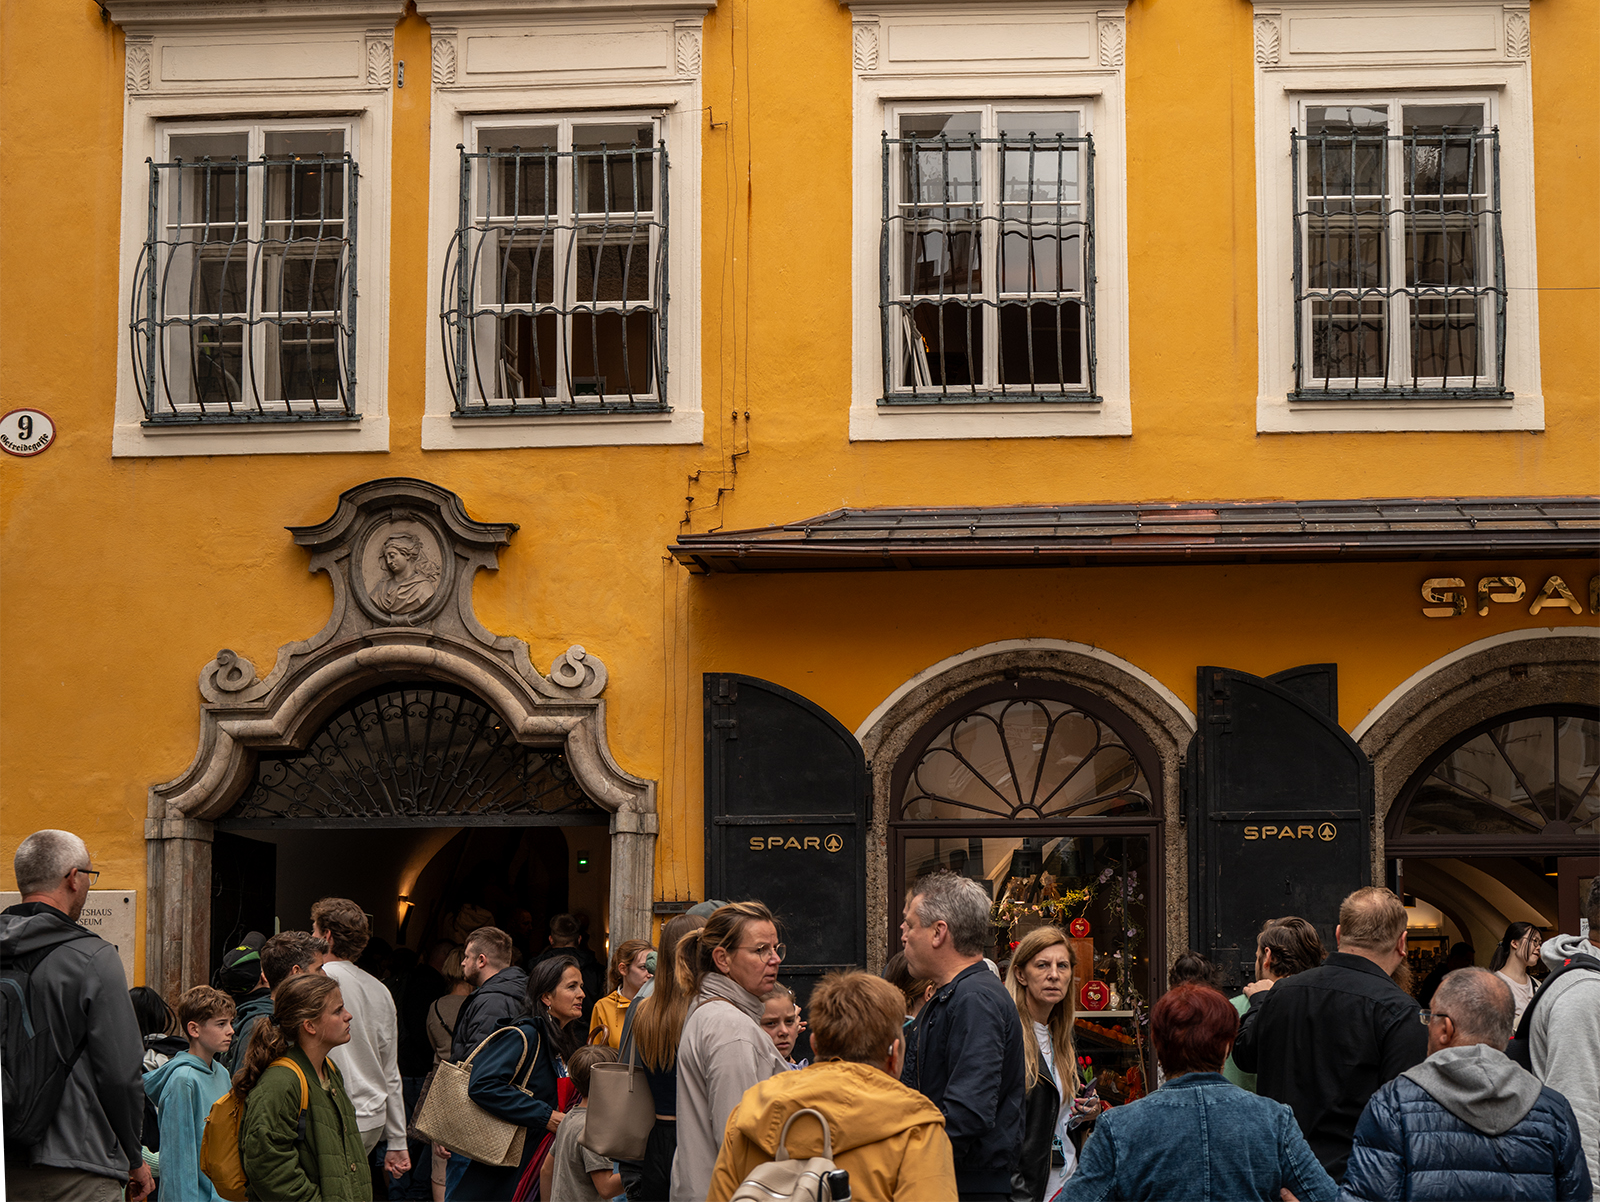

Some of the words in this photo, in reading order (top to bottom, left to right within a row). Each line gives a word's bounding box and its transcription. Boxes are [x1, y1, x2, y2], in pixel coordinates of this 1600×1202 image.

[18, 414, 33, 440] 9
[1244, 825, 1314, 840] SPAR
[749, 836, 821, 851] SPAR
[78, 918, 102, 926] SEUM
